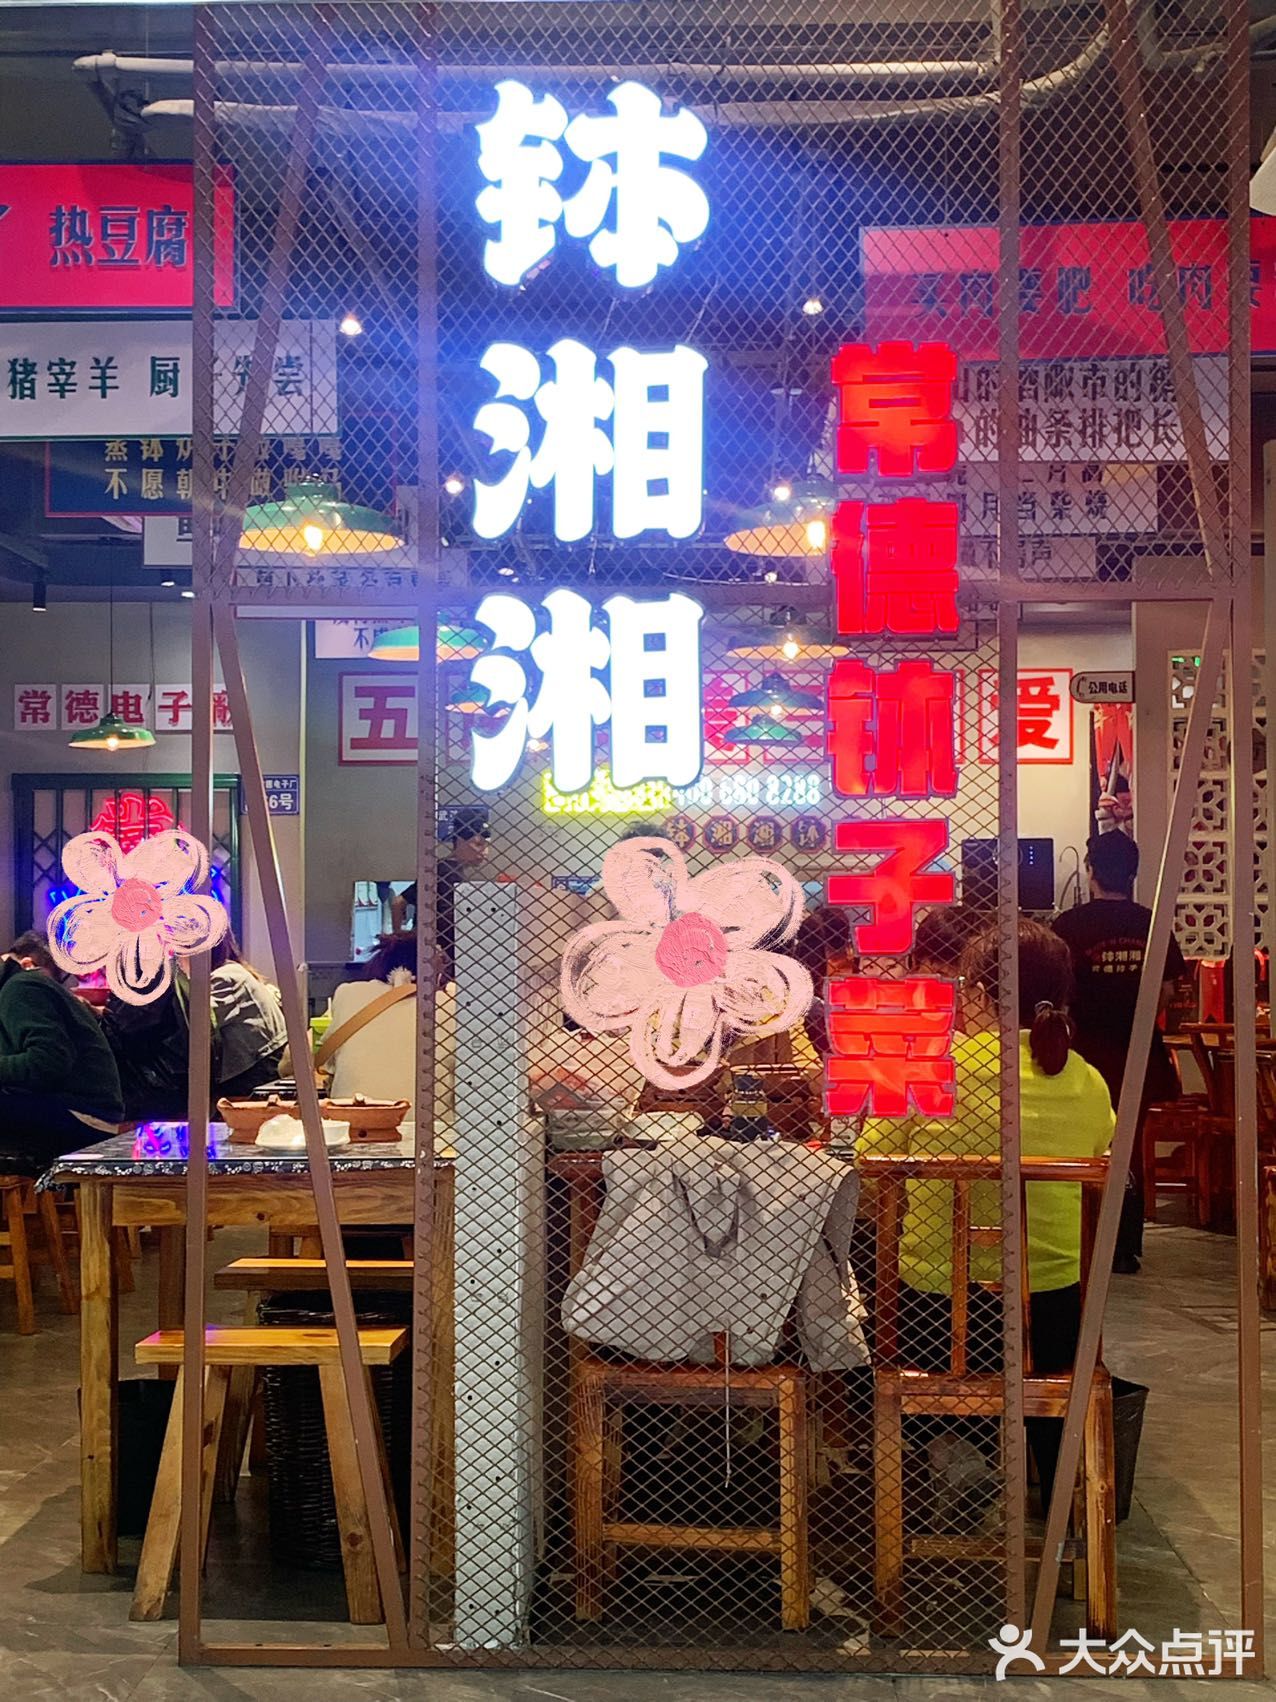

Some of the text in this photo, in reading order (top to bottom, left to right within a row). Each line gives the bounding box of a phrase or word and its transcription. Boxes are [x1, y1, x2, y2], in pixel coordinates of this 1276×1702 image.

[49, 205, 188, 267] 热豆腐
[8, 356, 120, 399] 猪宰羊
[472, 79, 711, 793] 钵湘湘
[350, 685, 419, 750] 五
[991, 675, 1061, 750] 爱
[1088, 679, 1129, 696] 公用电话
[825, 341, 960, 1117] 常德钵子菜
[268, 792, 294, 810] 6号
